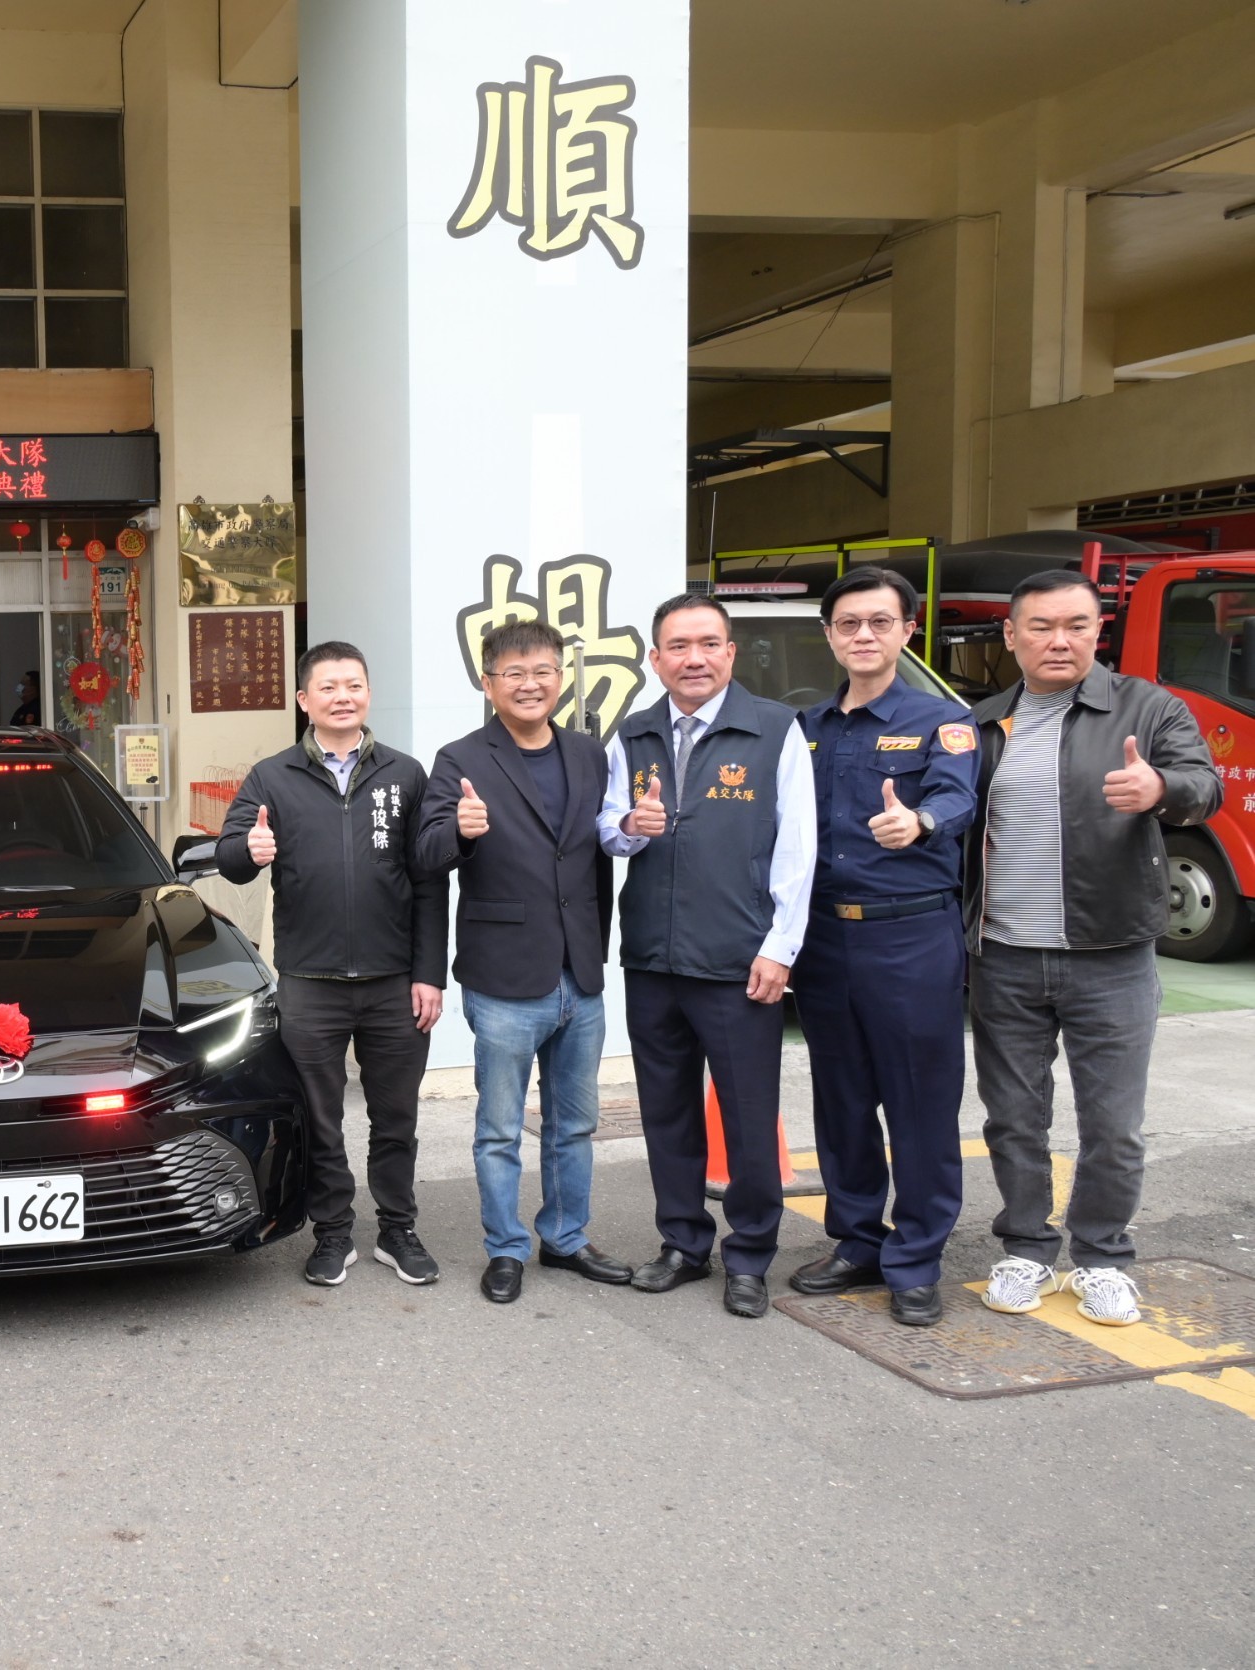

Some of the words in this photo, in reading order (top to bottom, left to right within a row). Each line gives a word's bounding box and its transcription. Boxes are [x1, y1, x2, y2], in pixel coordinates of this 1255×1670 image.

[391, 784, 401, 817] 副議長
[706, 786, 755, 801] 義交大隊
[371, 788, 389, 850] 曾俊傑
